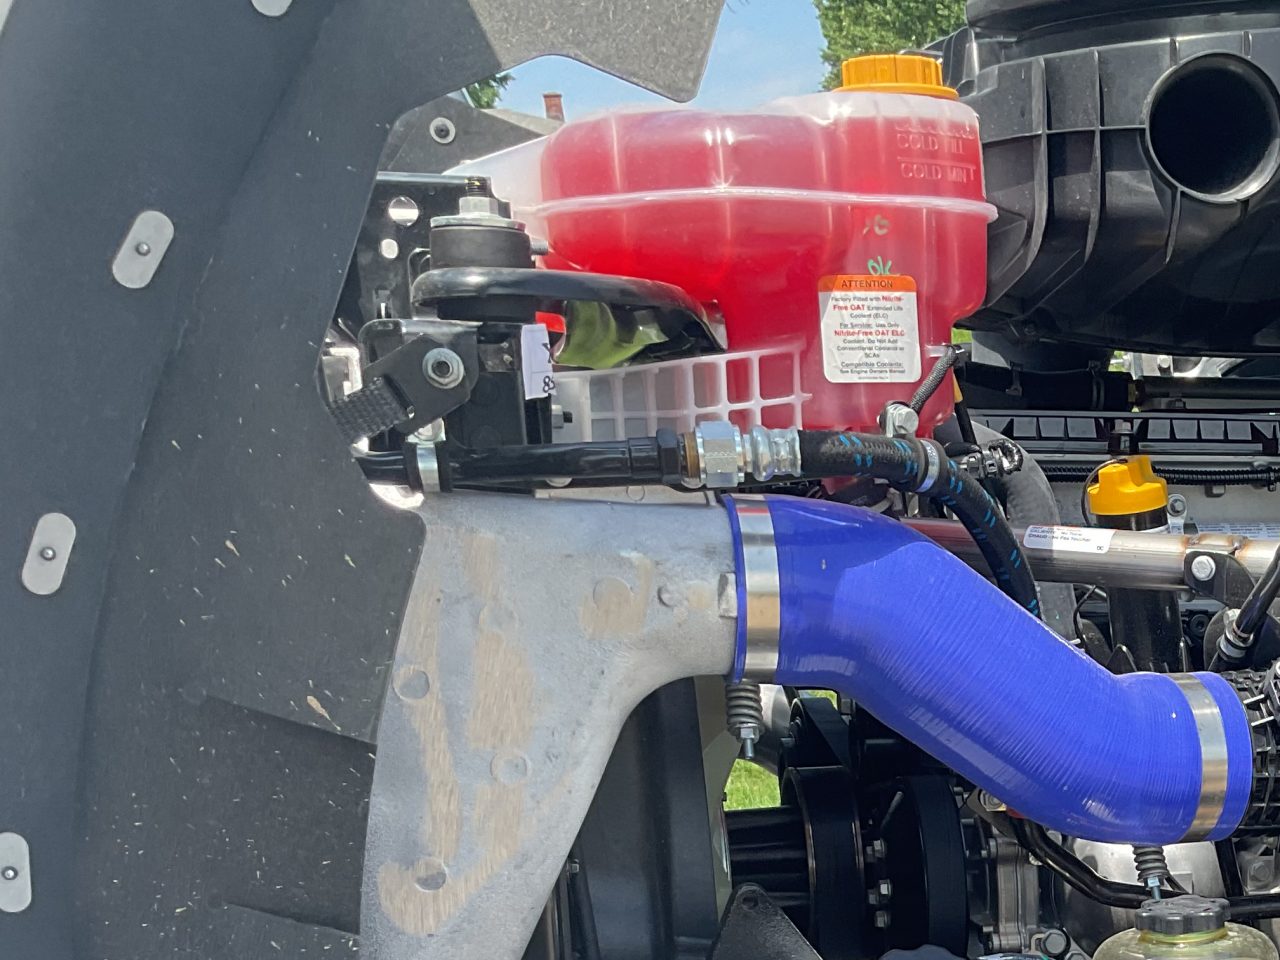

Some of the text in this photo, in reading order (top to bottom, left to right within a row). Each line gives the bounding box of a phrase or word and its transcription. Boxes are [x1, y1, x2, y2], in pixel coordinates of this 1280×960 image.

[897, 133, 939, 151] COLD
[901, 163, 942, 179] COLD
[841, 279, 893, 288] ATTENTION
